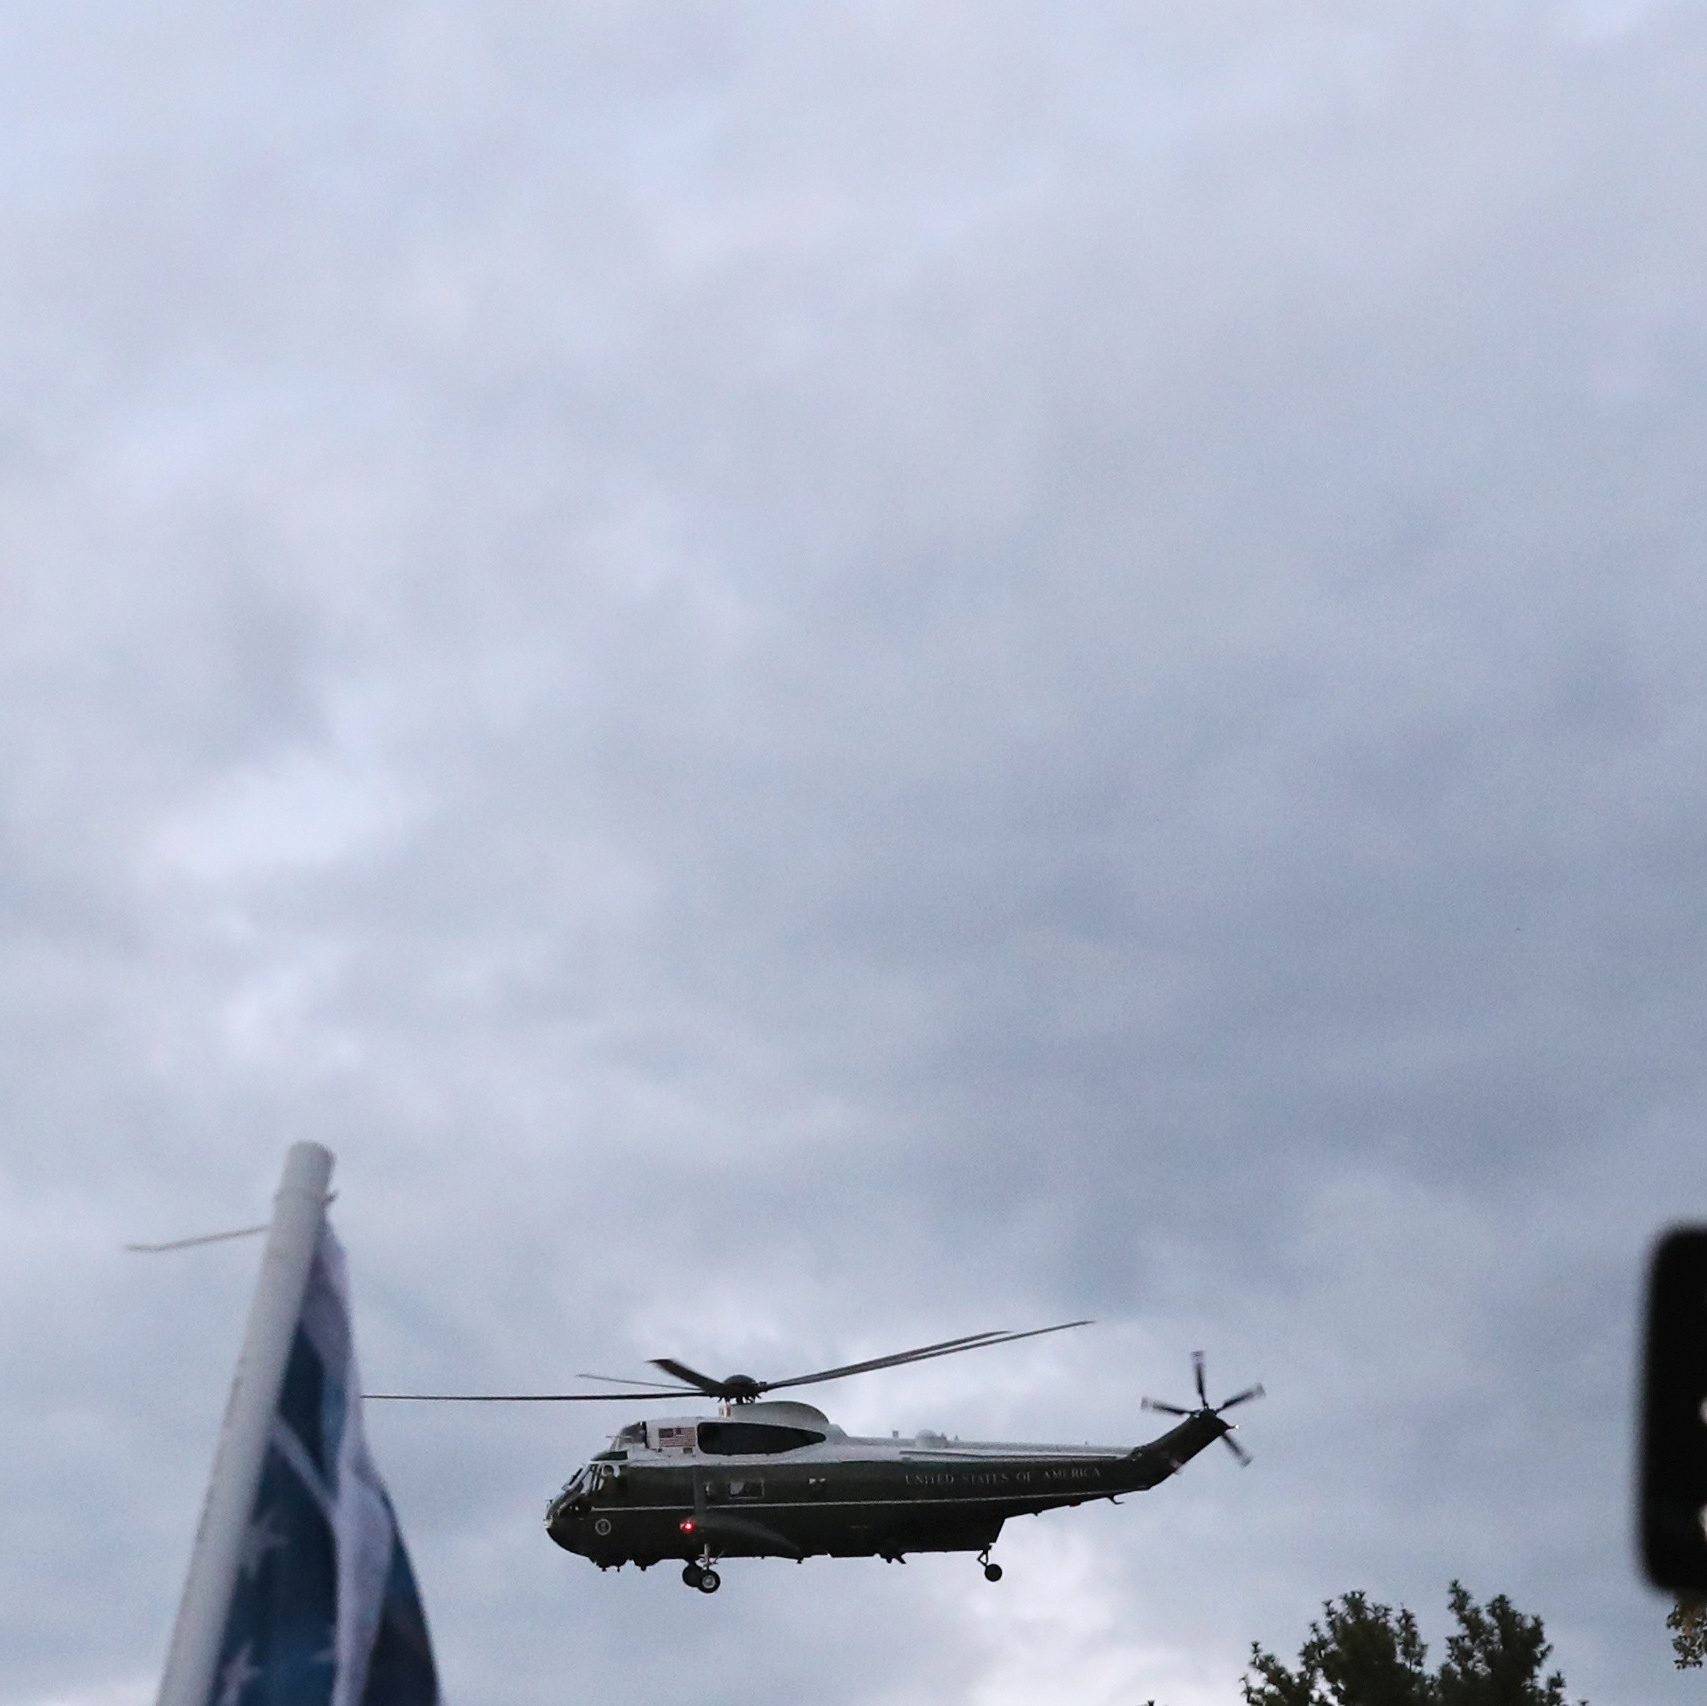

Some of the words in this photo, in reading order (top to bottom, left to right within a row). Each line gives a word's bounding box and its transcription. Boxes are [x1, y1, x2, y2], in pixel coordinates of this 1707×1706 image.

[905, 1473, 954, 1484] UNITED
[963, 1472, 1009, 1484] STATES
[1017, 1471, 1032, 1483] OF
[1044, 1467, 1101, 1480] AMERICA
